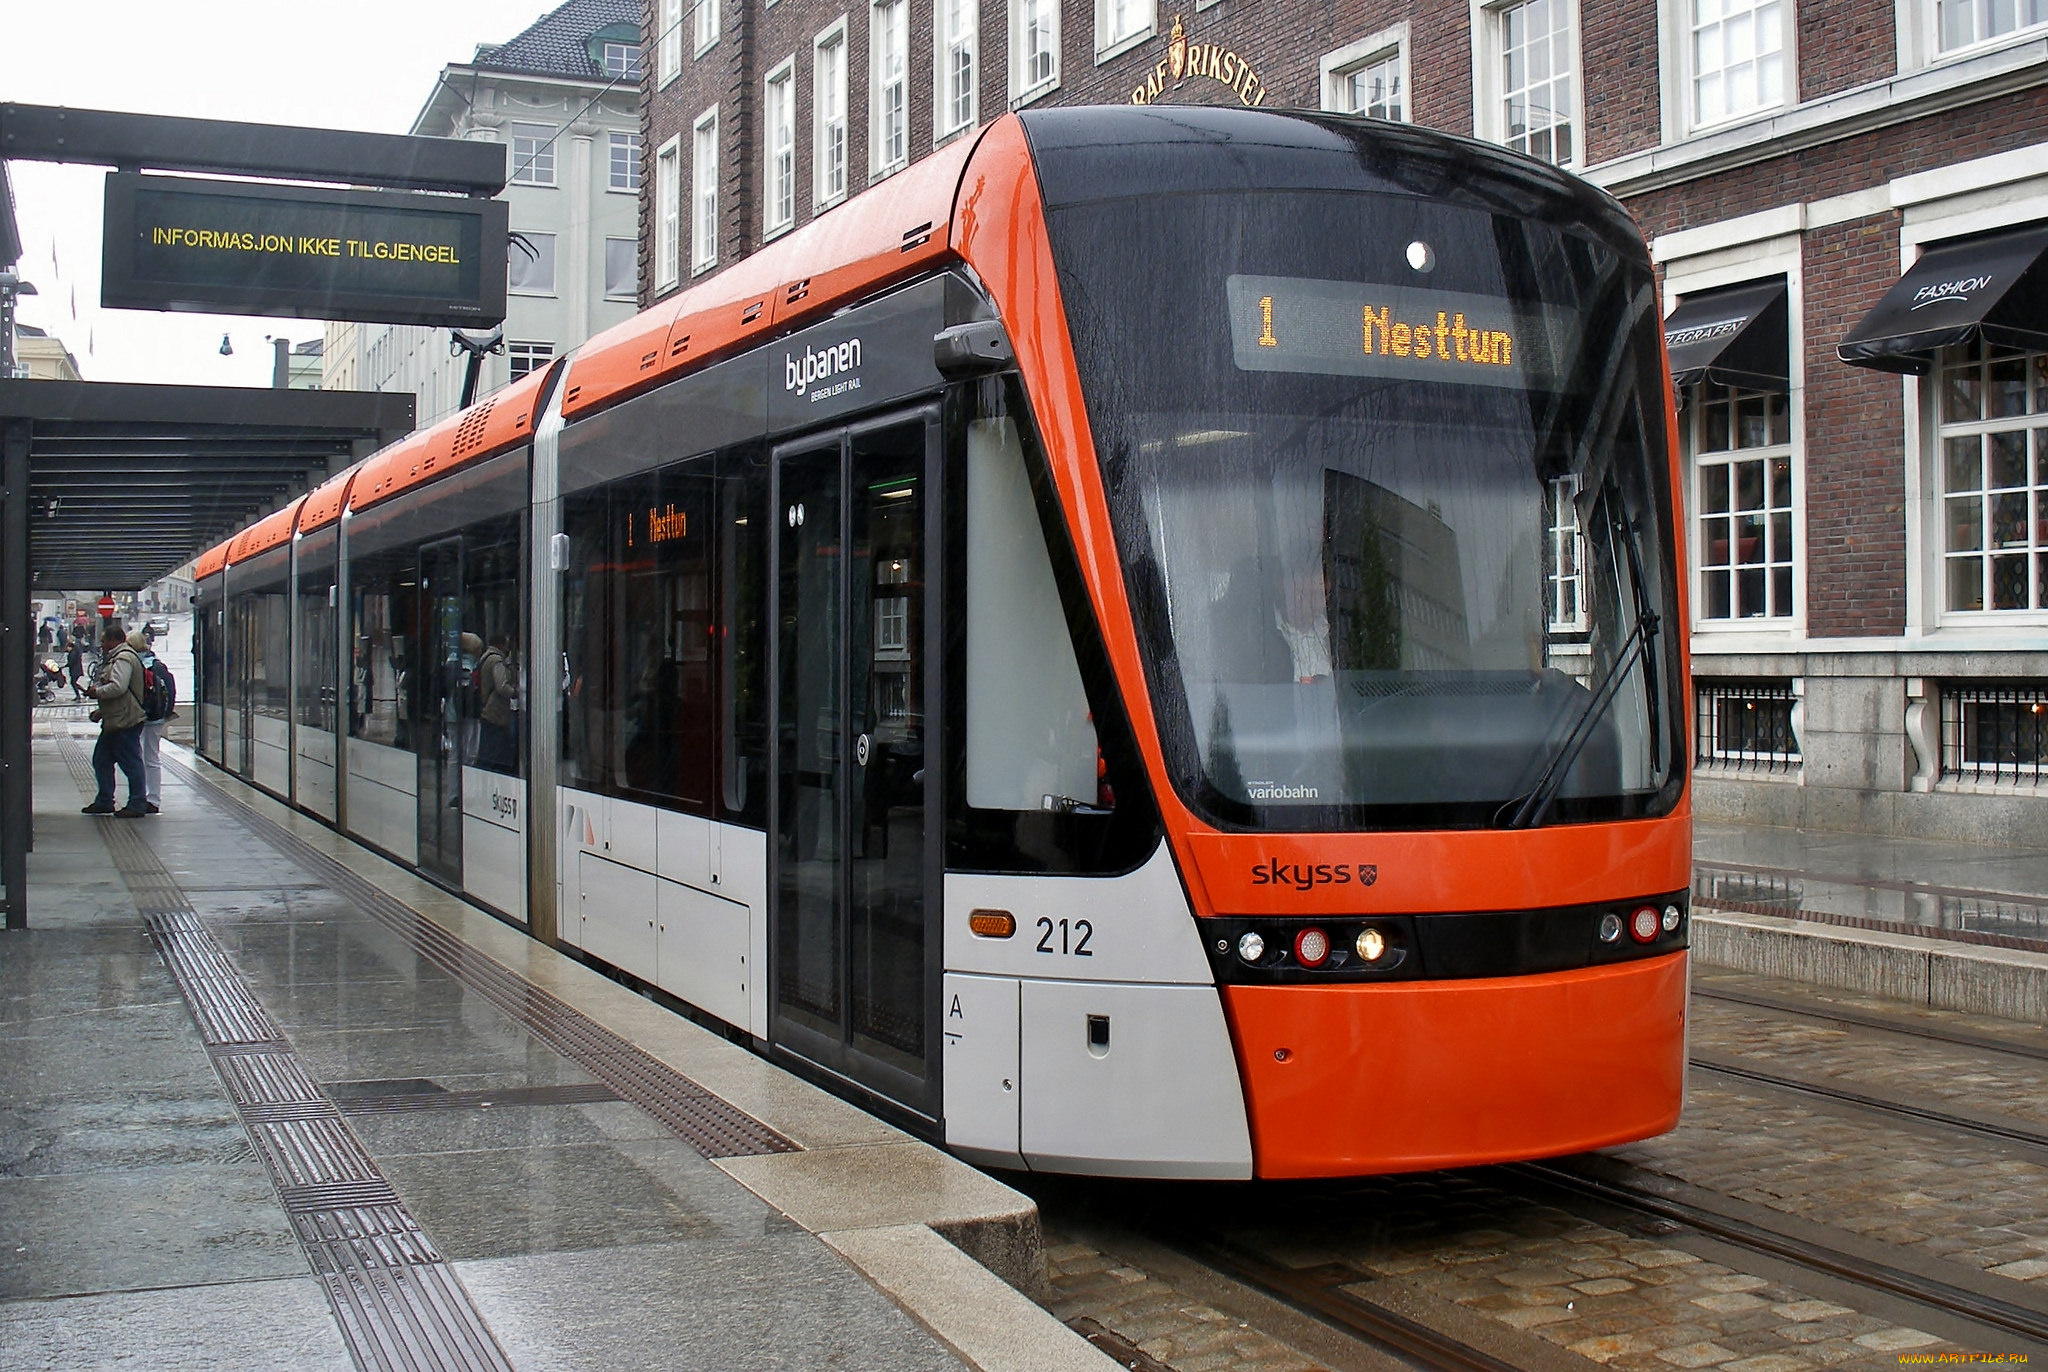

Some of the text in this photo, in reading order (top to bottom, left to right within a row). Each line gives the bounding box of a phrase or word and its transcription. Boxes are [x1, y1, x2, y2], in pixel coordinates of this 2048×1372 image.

[1129, 58, 1168, 105] RAF
[152, 227, 460, 264] INFORMASJON IKKE TILGJENGEL
[1913, 275, 1992, 301] FASHION
[1258, 296, 1512, 365] 1 Nesttun
[786, 338, 861, 396] bybanen
[810, 378, 862, 403] BERGEN LIGHT RAIL
[649, 503, 687, 542] Nesttun
[1247, 784, 1319, 799] variobahn
[1251, 857, 1351, 891] skyss
[1036, 916, 1093, 957] 212
[949, 993, 963, 1019] A
